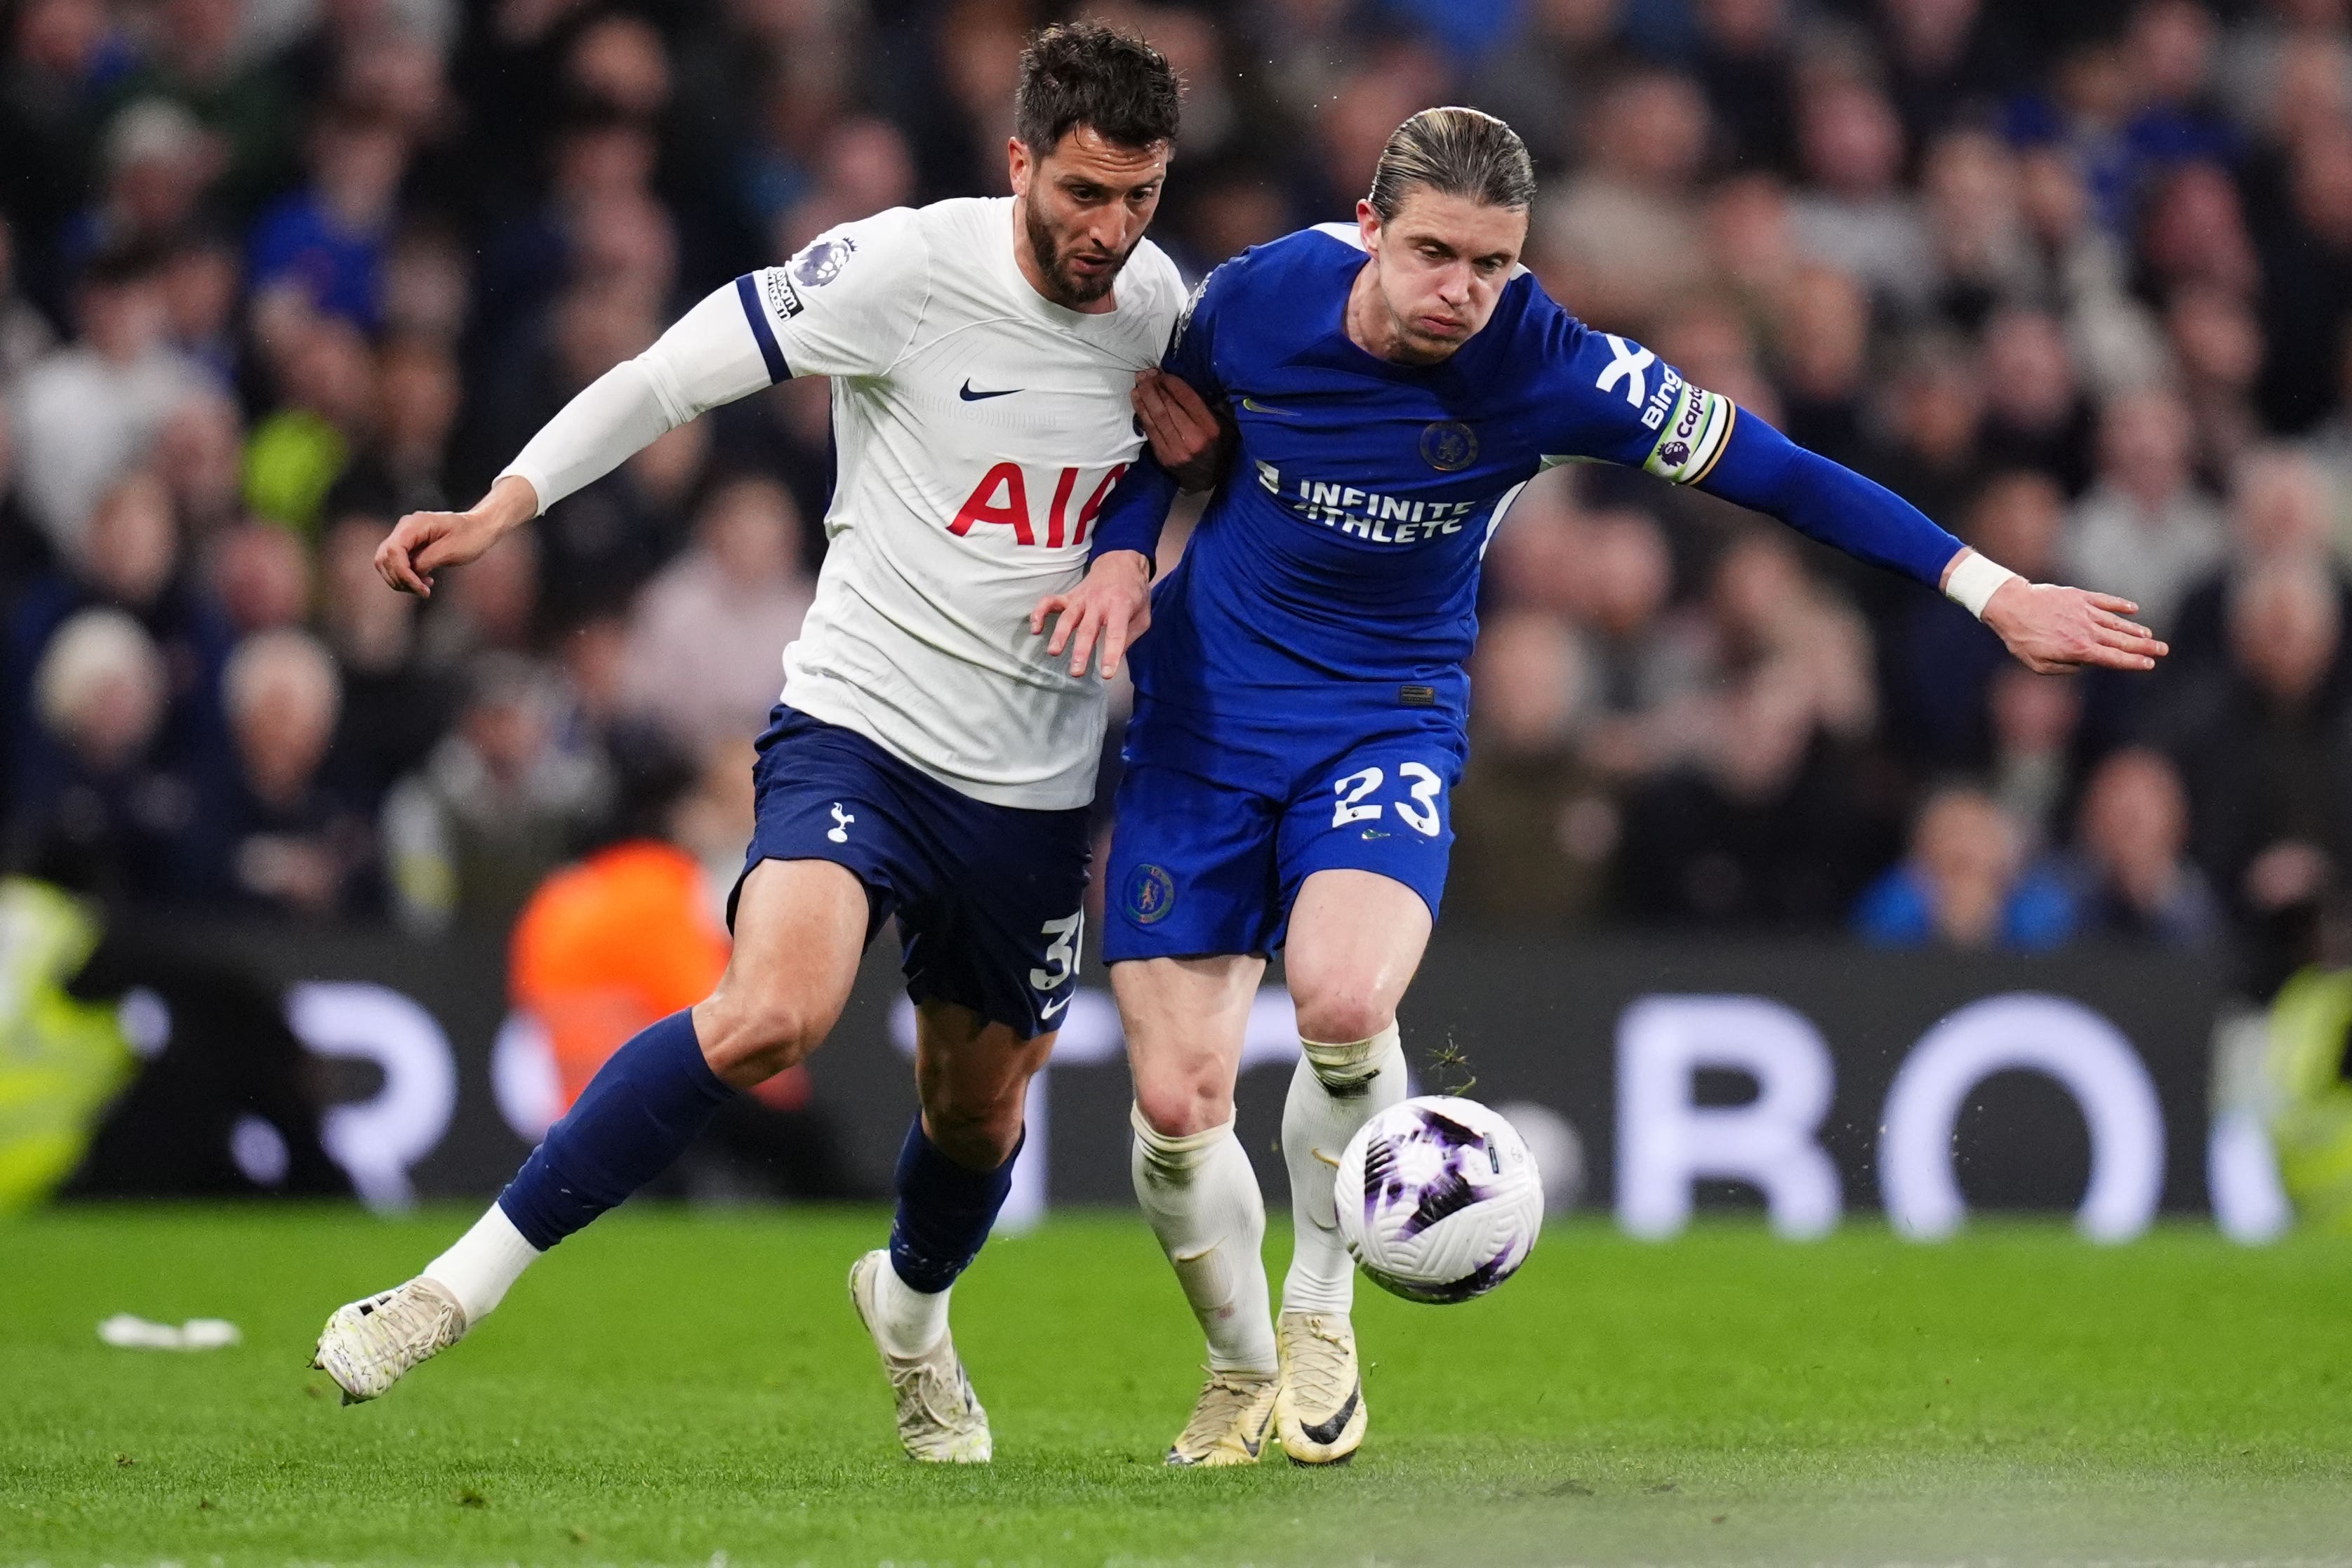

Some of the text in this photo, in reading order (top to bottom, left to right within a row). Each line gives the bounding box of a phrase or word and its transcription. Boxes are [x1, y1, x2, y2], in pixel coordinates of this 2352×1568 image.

[1301, 479, 1476, 522] INFINITE
[1332, 762, 1442, 837] 23
[1030, 904, 1084, 990] 3
